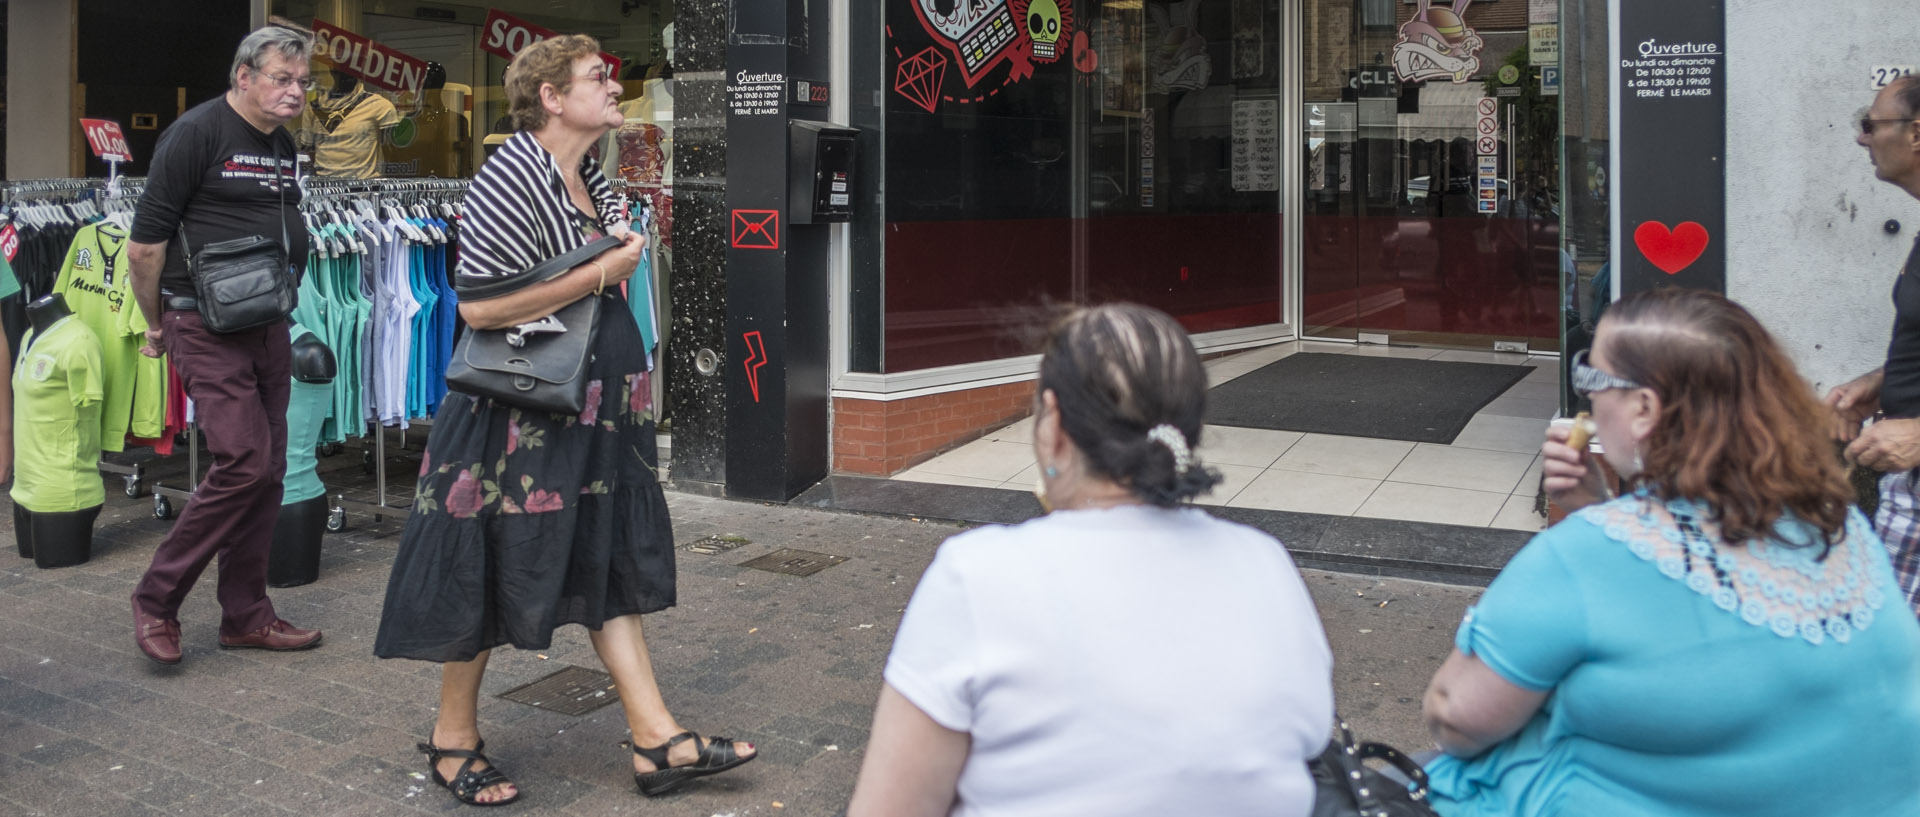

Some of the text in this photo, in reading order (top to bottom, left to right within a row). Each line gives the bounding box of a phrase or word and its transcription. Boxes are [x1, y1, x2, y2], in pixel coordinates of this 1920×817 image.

[1638, 38, 1717, 58] Ouverture
[314, 28, 421, 94] SOLDEN
[1621, 60, 1634, 68] Du
[1635, 59, 1656, 67] lundi
[1671, 58, 1716, 66] dimanche
[736, 69, 783, 85] Ouverture
[1546, 70, 1557, 83] P
[1636, 69, 1649, 77] De
[1651, 68, 1675, 76] 10h30
[1686, 67, 1711, 75] 12h00
[1627, 79, 1635, 87] &
[1636, 79, 1649, 87] de
[1651, 78, 1675, 86] 13h30
[1686, 77, 1711, 85] 19h00
[811, 86, 828, 102] 223
[1636, 88, 1711, 98] FERMÉ LE MARDI
[735, 107, 752, 115] FERMÉ
[232, 154, 260, 165] SPORT
[77, 247, 92, 270] R
